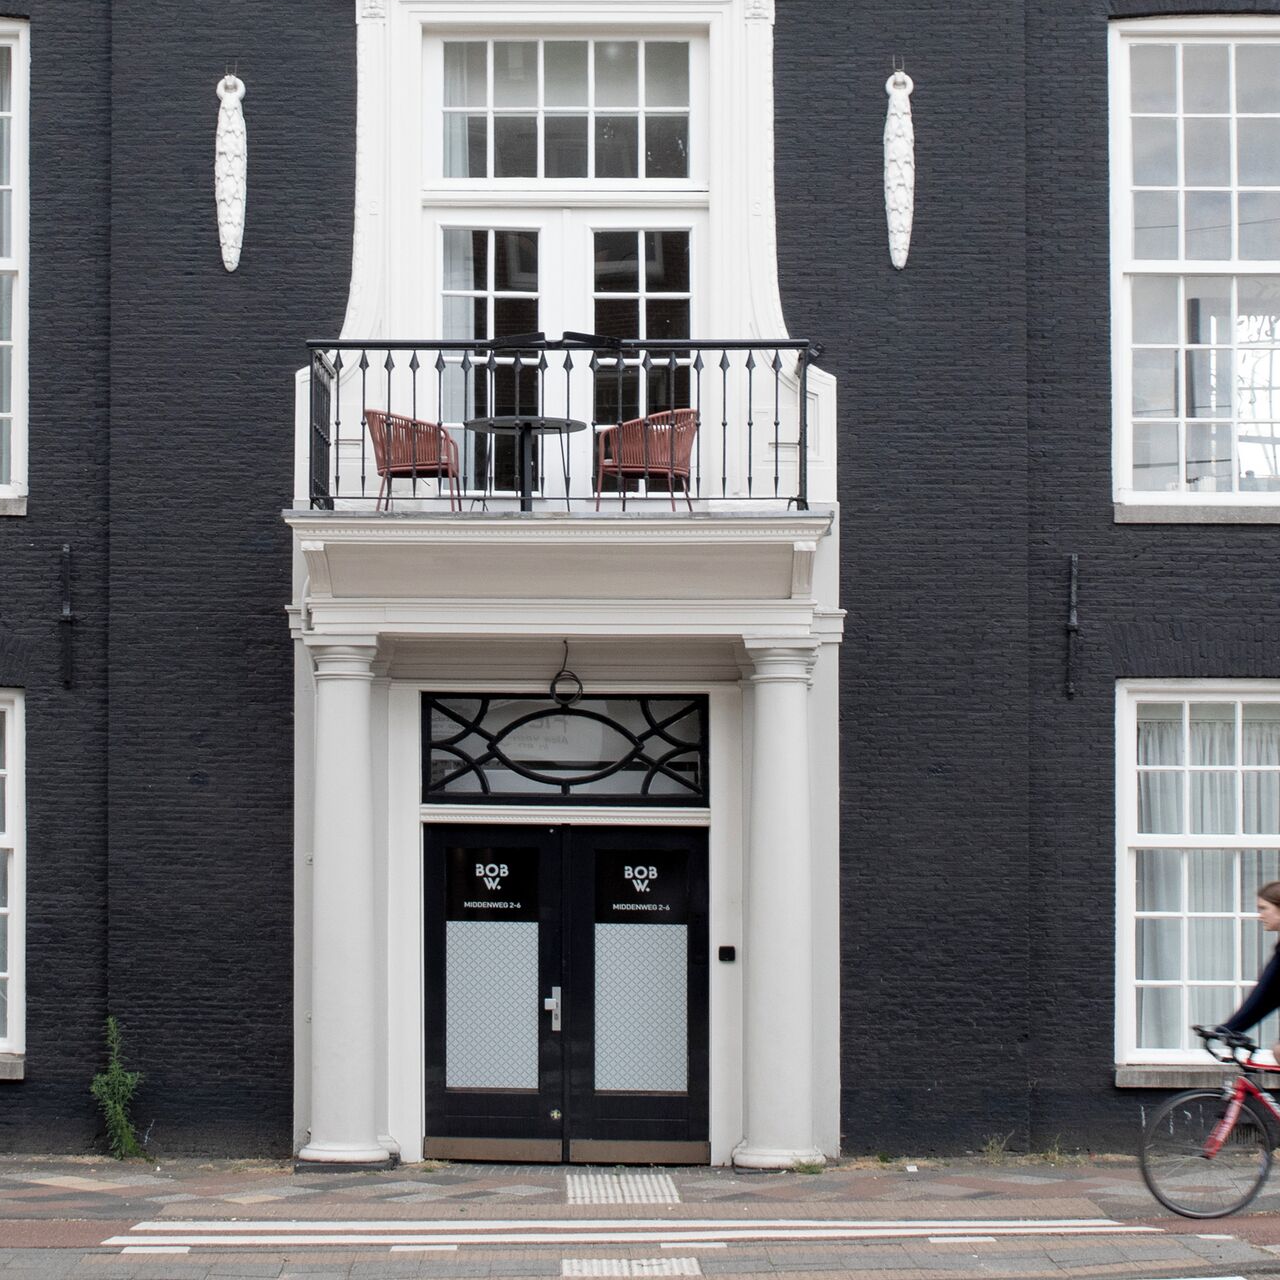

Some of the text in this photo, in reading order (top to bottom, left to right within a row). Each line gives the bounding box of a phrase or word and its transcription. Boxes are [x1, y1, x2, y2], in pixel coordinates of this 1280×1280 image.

[475, 863, 509, 877] BOB
[624, 865, 658, 879] BOB
[483, 877, 502, 890] W.
[632, 879, 650, 892] W.
[509, 901, 521, 909] 2-6
[612, 903, 658, 911] MIDDENWEG
